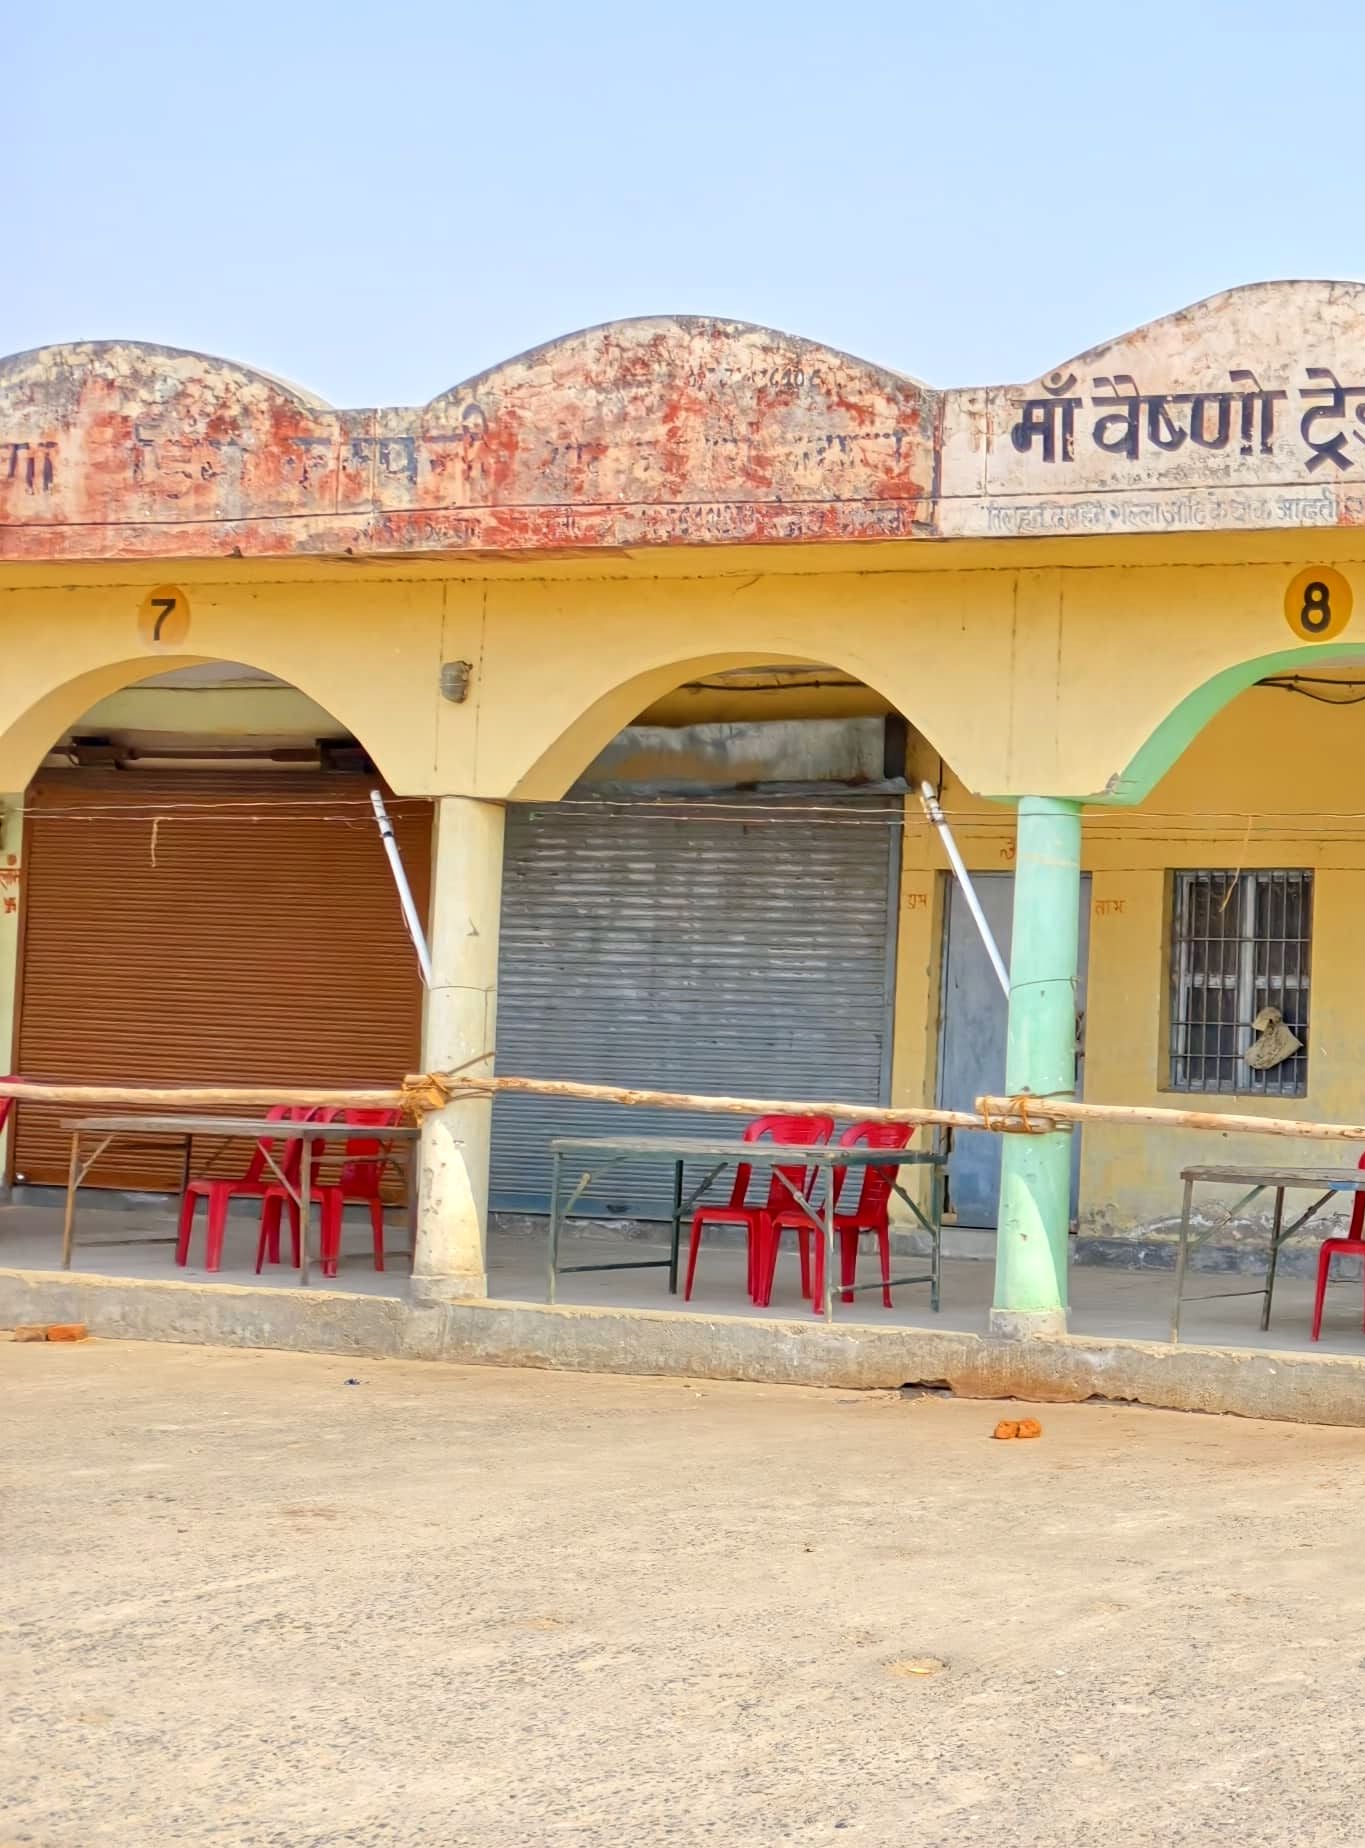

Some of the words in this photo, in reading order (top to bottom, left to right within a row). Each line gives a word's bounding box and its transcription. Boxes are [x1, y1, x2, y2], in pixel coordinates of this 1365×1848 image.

[1010, 371, 1082, 464] माँ
[1091, 370, 1288, 461] वैष्णो
[150, 598, 177, 642] 7
[1300, 581, 1332, 634] 8
